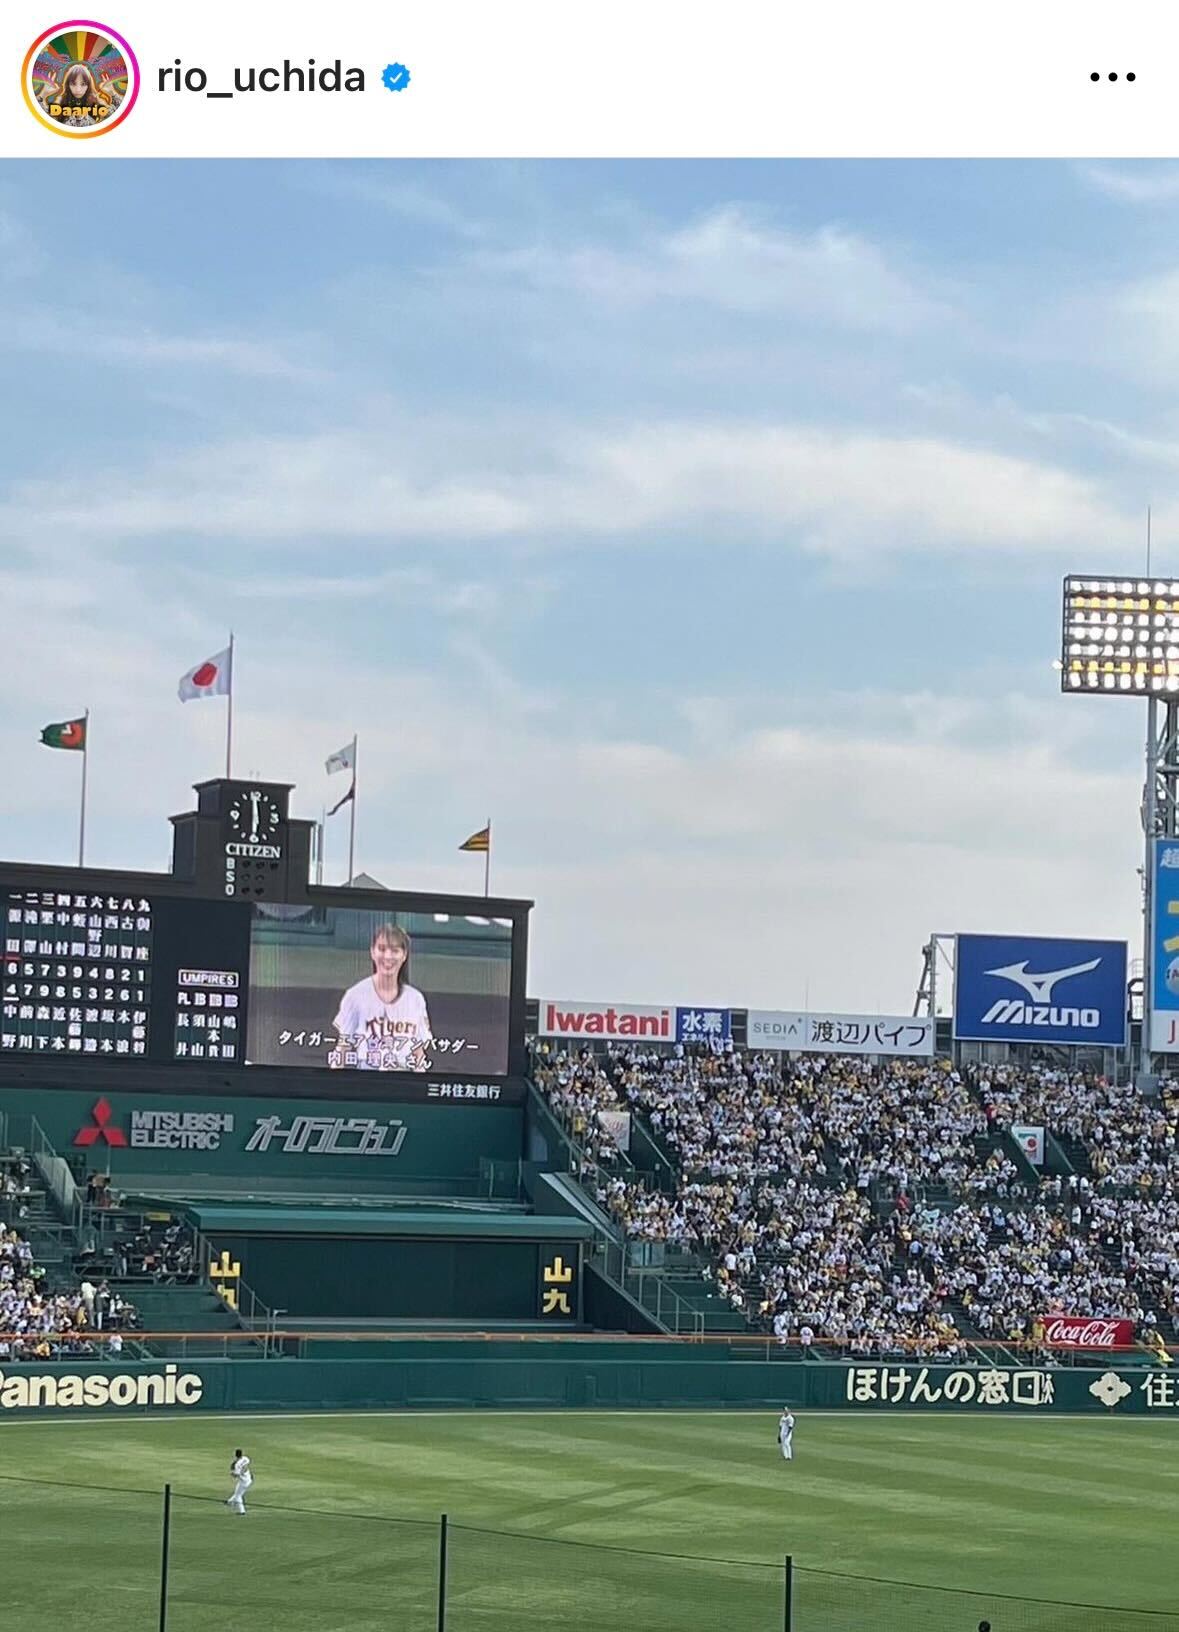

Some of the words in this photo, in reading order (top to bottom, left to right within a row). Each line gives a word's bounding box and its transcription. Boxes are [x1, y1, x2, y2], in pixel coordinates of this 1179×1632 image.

[250, 791, 261, 802] 12
[230, 810, 240, 821] 9
[270, 812, 280, 824] 3
[249, 833, 259, 843] 6
[225, 843, 281, 859] CITIZEN
[25, 892, 39, 904] 二
[41, 892, 55, 906] 三
[74, 895, 87, 908] 五
[90, 896, 103, 909] 六
[107, 896, 119, 910] 七
[122, 898, 135, 911] 八
[137, 898, 151, 912] 九
[7, 909, 22, 953] 田
[56, 911, 70, 956] 中村
[105, 915, 119, 959] 西川
[8, 962, 18, 975] 6
[24, 963, 34, 976] 5
[41, 964, 50, 977] 7
[57, 965, 67, 978] 3
[73, 966, 83, 978] 9
[89, 967, 99, 979] 4
[105, 968, 115, 980] 8
[121, 968, 131, 981] 2
[138, 969, 144, 982] 1
[182, 973, 234, 985] UMPIRES
[6, 983, 17, 995] 4
[24, 983, 33, 996] 7
[40, 984, 50, 997] 9
[55, 985, 66, 998] 8
[72, 986, 82, 999] 5
[88, 987, 98, 999] 3
[104, 988, 114, 1000] 2
[120, 989, 130, 1001] 6
[137, 990, 143, 1002] 1
[2, 1004, 17, 1048] 中野
[547, 1004, 669, 1037] Iwatani
[682, 1011, 723, 1033] 水素
[753, 1022, 798, 1035] SEDIA
[812, 1020, 932, 1047] 渡辺パイプ
[327, 1051, 358, 1067] 内田
[406, 1054, 432, 1069] さん
[427, 1083, 501, 1099] 三井住友銀行
[131, 1111, 233, 1132] MITSUBISHI
[130, 1129, 221, 1149] ELECTRIC
[543, 1256, 572, 1313] 山九
[1047, 1319, 1121, 1346] Coca-Cola
[0, 1364, 203, 1408] anasonic
[847, 1367, 1043, 1406] ほけんの窓口
[1140, 1373, 1179, 1407] 住
